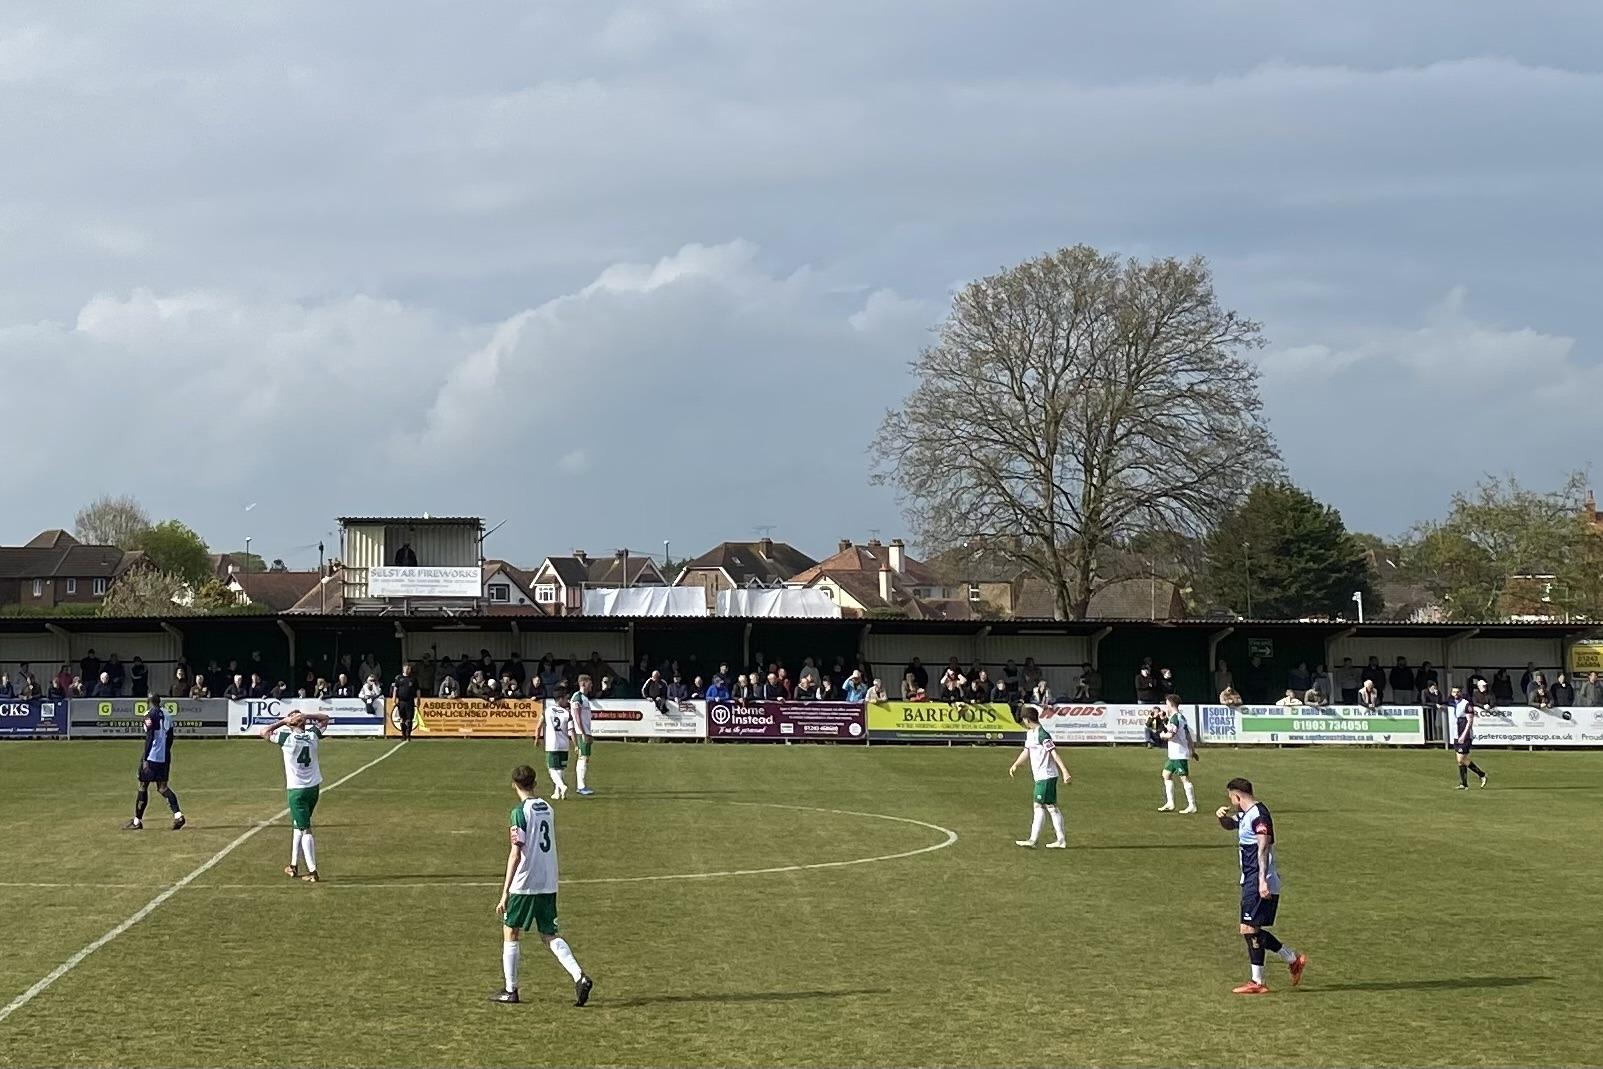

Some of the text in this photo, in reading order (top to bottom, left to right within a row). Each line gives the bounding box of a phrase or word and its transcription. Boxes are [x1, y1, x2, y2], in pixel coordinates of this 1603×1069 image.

[418, 568, 479, 578] FIREWORKS
[423, 702, 532, 710] ASBESTOS REMOVAL FOR
[731, 704, 765, 716] Home
[240, 701, 281, 732] JPC
[423, 710, 488, 718] NON-LICENSED
[902, 707, 997, 722] BARFOOTS
[1039, 705, 1107, 719] WOODS
[1120, 709, 1136, 717] THE
[1209, 707, 1236, 717] SOUTH
[1251, 708, 1267, 716] SKIP
[1480, 710, 1513, 718] COOPER
[553, 716, 562, 732] 2
[1209, 717, 1236, 726] COAST
[1292, 720, 1369, 731] 01903 734056
[1209, 726, 1237, 735] SKIPS
[296, 746, 312, 767] 4
[539, 820, 551, 853] 3
